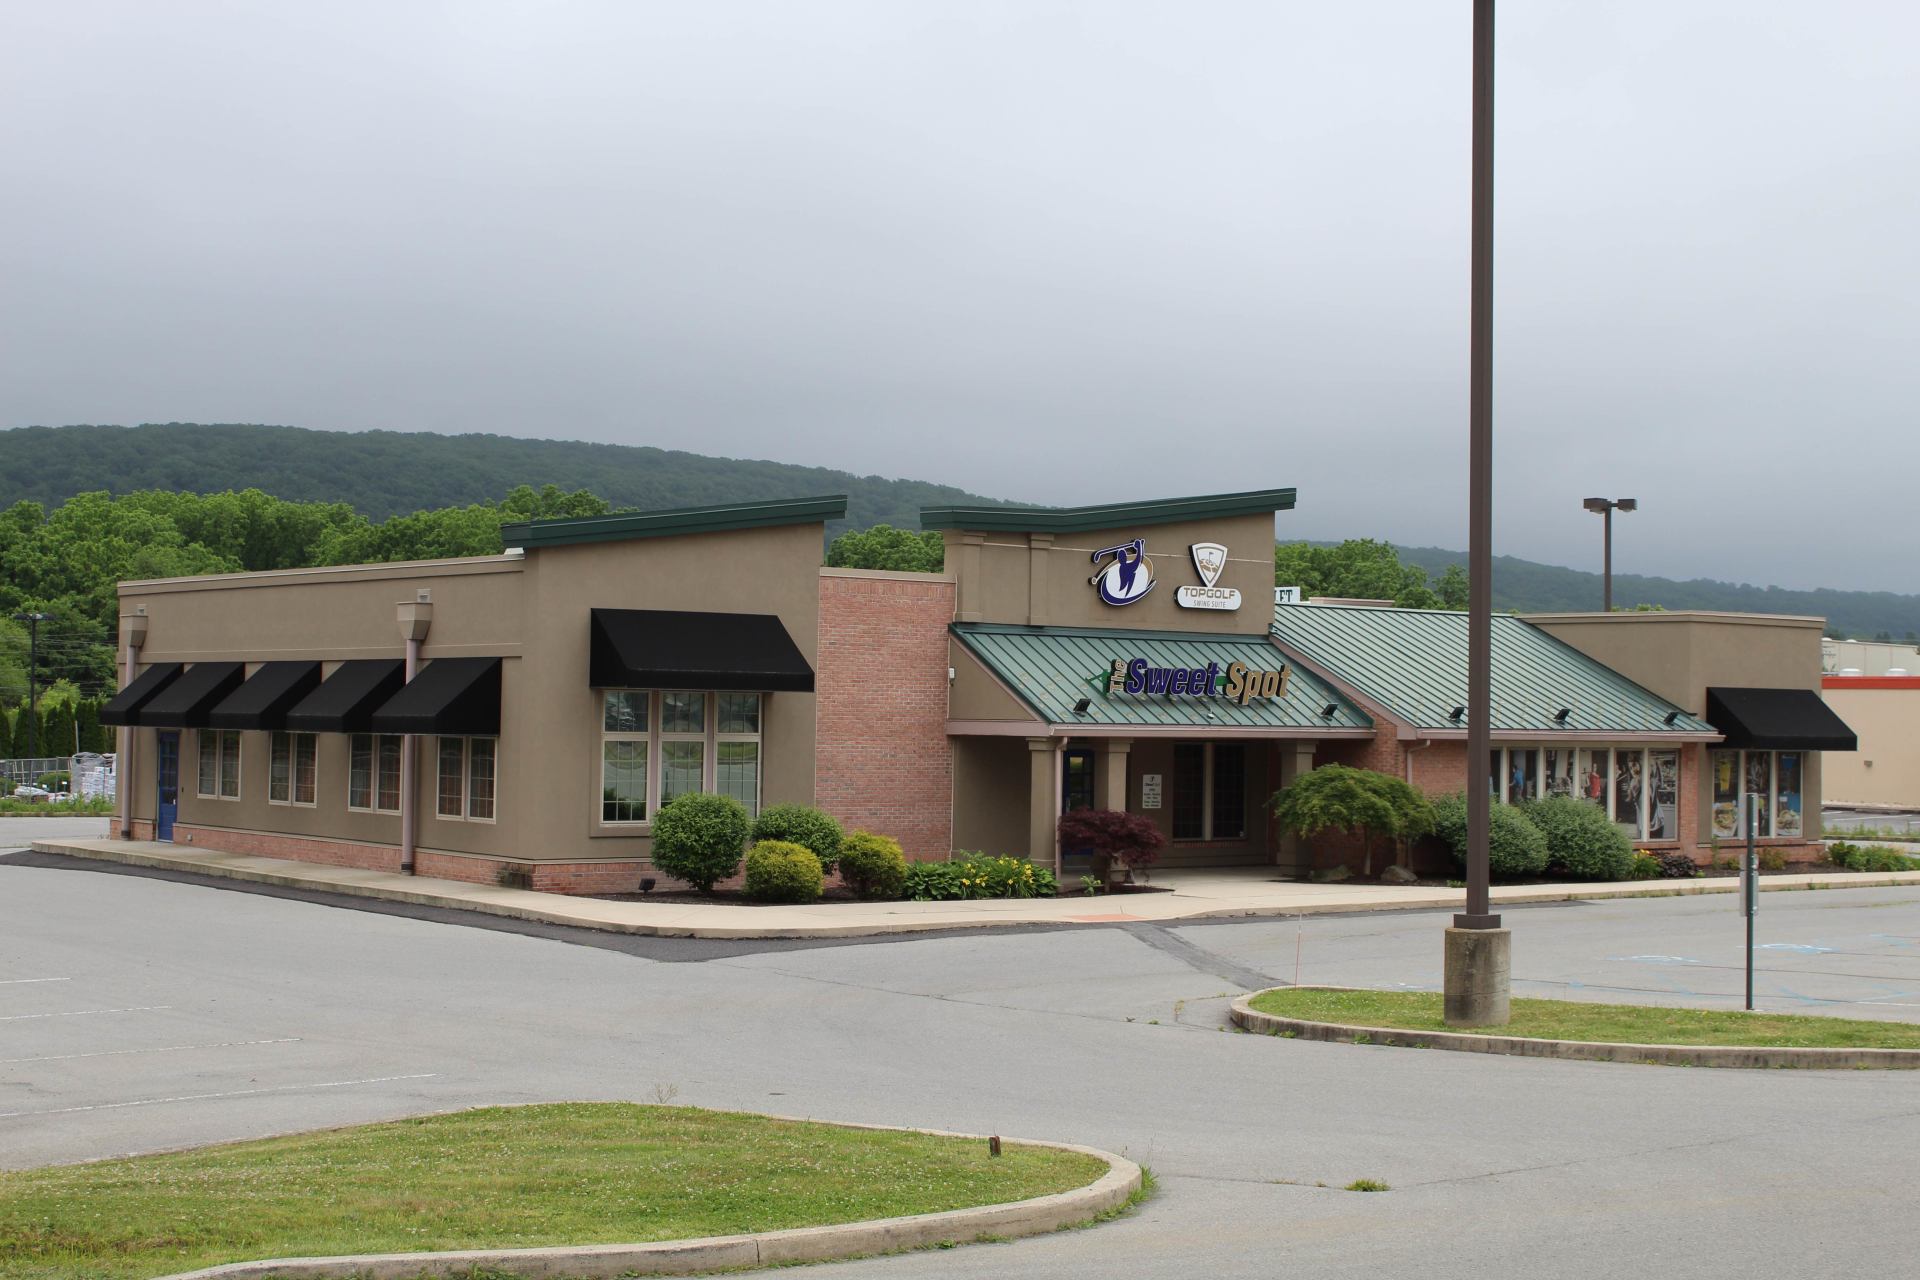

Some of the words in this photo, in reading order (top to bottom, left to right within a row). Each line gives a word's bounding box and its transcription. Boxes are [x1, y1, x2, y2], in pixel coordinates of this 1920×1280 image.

[1183, 587, 1236, 599] TOPGOLF
[1212, 600, 1226, 608] SUITE
[1109, 658, 1127, 694] The
[1126, 657, 1220, 697] Sweet
[1225, 660, 1292, 706] Spot
